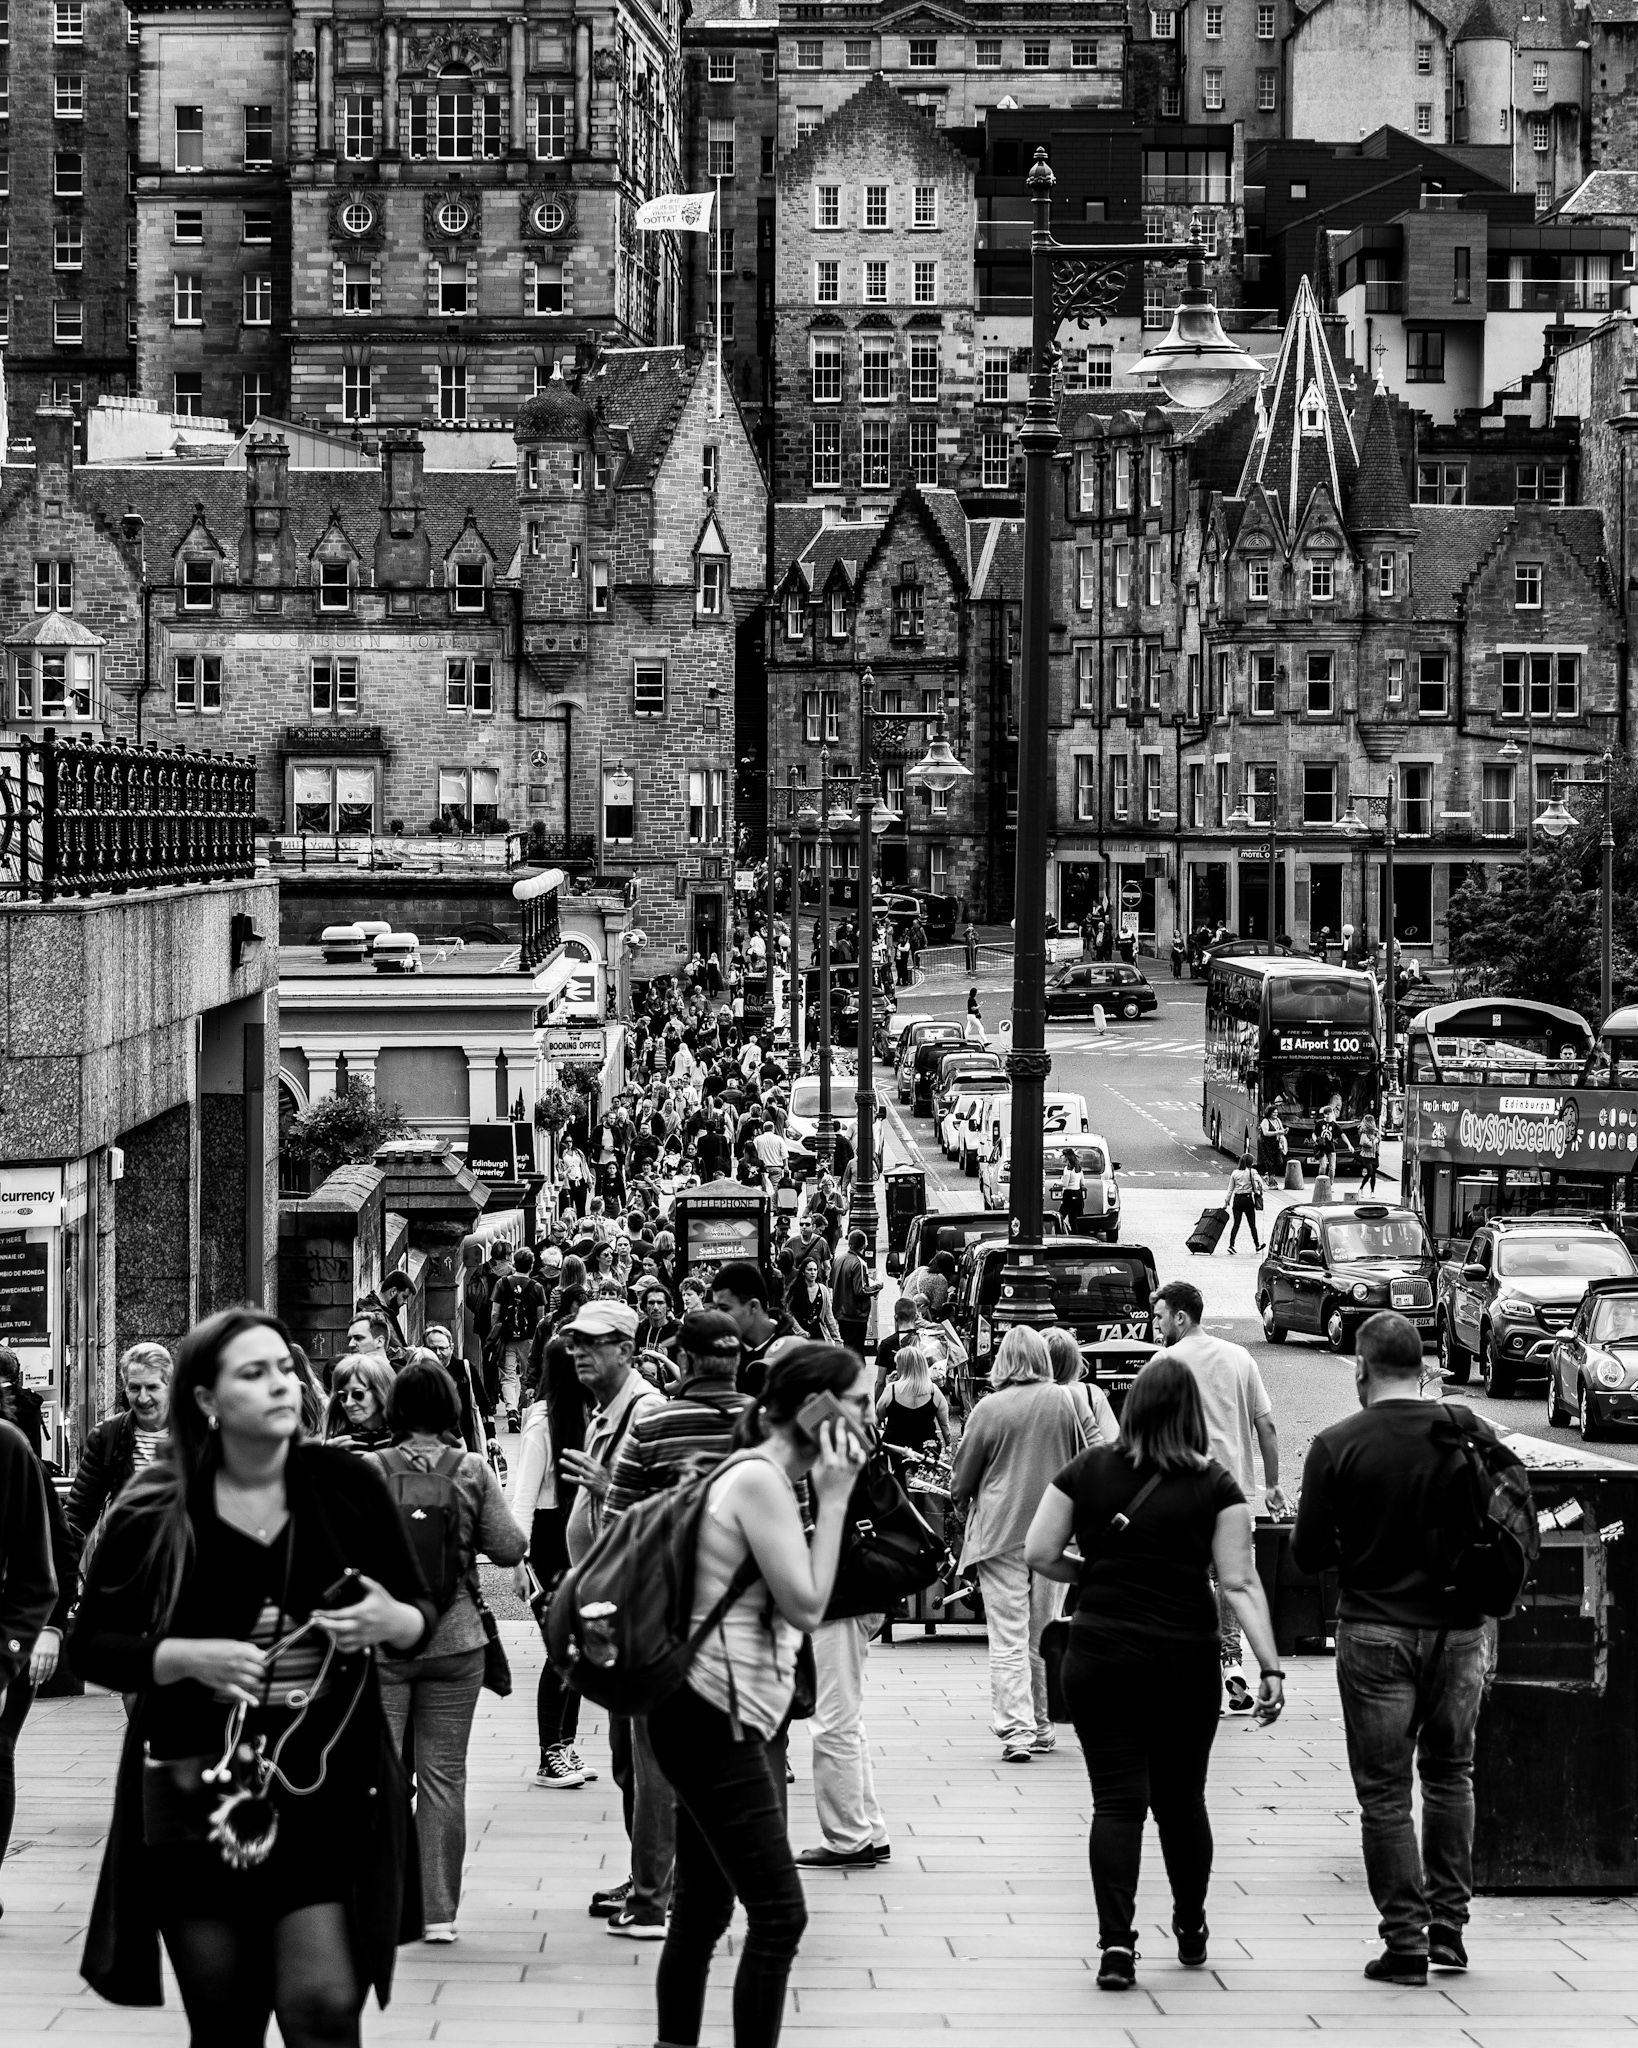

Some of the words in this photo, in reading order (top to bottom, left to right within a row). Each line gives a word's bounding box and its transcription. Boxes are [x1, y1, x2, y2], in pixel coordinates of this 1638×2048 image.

[193, 635, 236, 647] THE
[257, 635, 381, 648] COCKBURN
[402, 635, 478, 648] HOTEL
[549, 1042, 577, 1050] BOOKING
[579, 1041, 601, 1049] OFFICE
[1294, 1038, 1329, 1051] Airport
[1333, 1037, 1360, 1052] 100
[1423, 1100, 1432, 1113] Hop
[1432, 1100, 1439, 1112] On
[1441, 1100, 1451, 1113] Hop
[1451, 1100, 1460, 1112] Off
[1504, 1098, 1550, 1110] Edinburgh
[472, 1159, 509, 1169] Edinburgh
[472, 1168, 505, 1178] Waverley
[1113, 1170, 1212, 1178] SLO
[1, 1191, 55, 1203] currency
[694, 1199, 753, 1208] TELEPHONE
[6, 1236, 22, 1244] HERE
[716, 1246, 734, 1254] STEM
[734, 1245, 746, 1253] Lab
[1130, 1311, 1149, 1319] V220
[1416, 1318, 1430, 1326] SUX
[1097, 1323, 1148, 1341] TAXI
[1111, 1381, 1133, 1390] Litte
